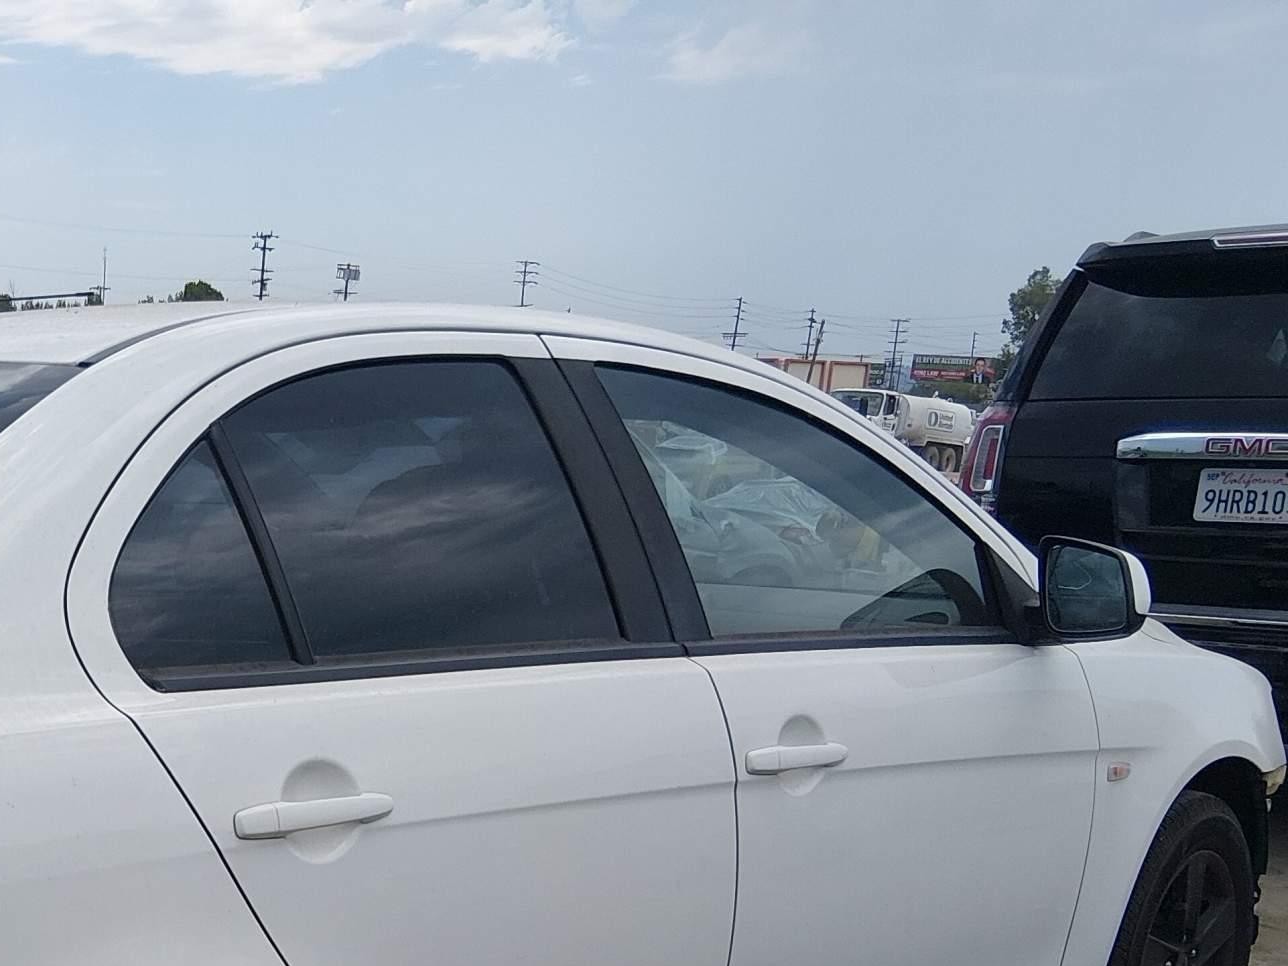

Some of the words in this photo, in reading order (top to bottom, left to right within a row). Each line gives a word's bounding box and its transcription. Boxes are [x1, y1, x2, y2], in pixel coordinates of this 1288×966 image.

[1205, 437, 1288, 456] GMC
[1222, 472, 1285, 488] California
[1202, 489, 1288, 515] 9HRB10
